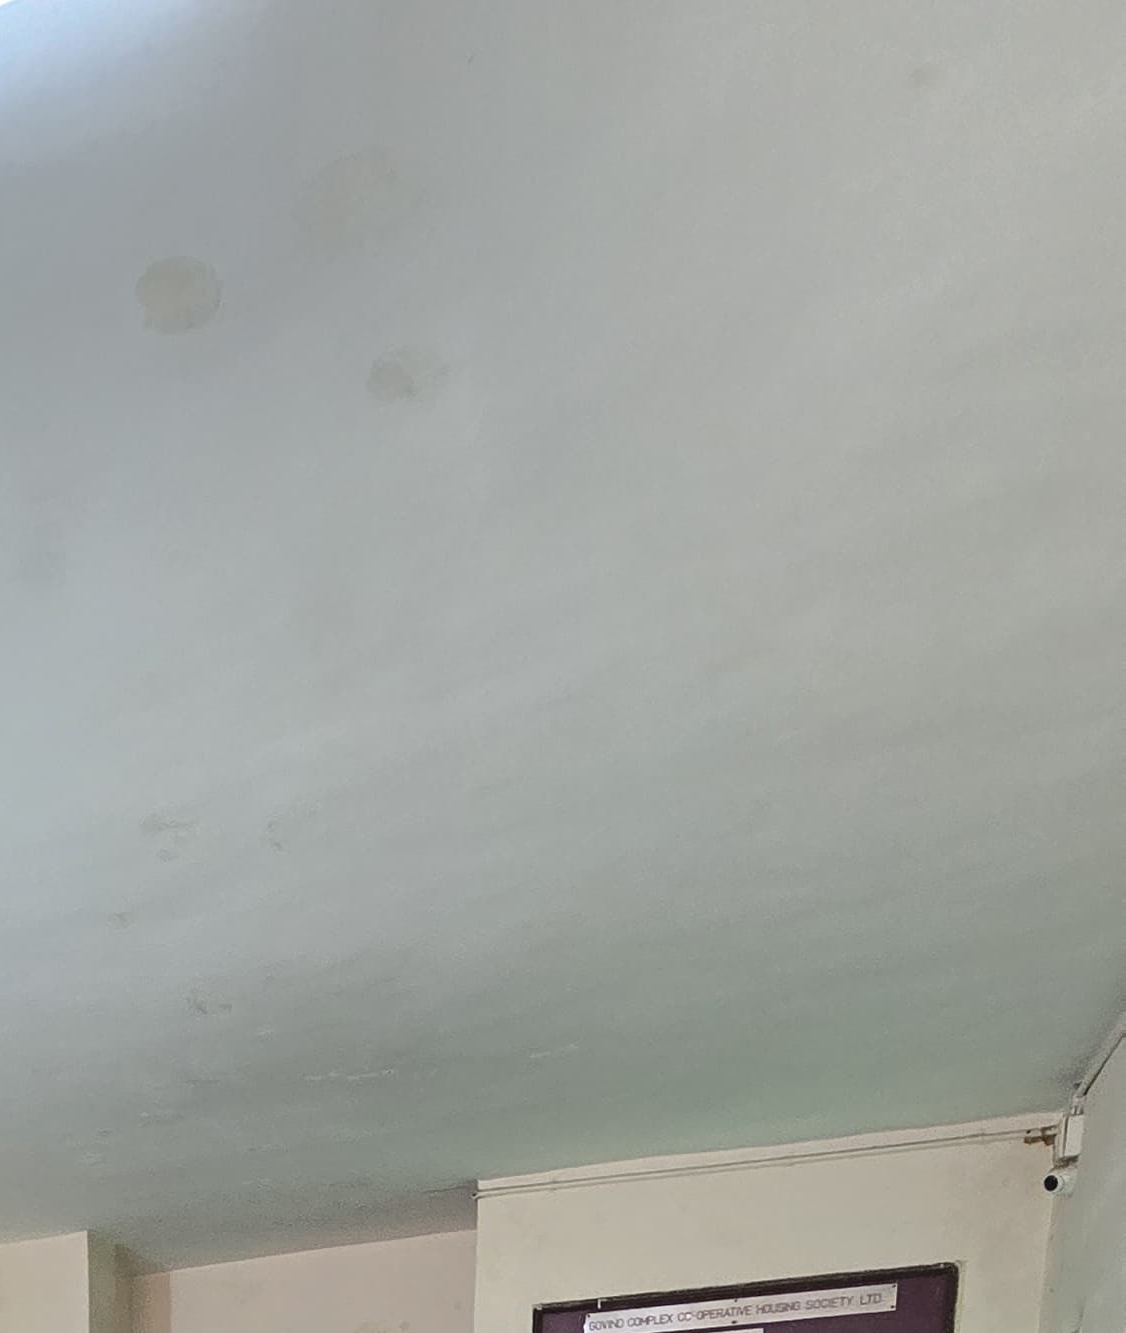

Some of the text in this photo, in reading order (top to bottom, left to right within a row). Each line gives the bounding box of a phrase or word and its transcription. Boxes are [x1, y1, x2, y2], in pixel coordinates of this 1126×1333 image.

[628, 1314, 674, 1328] COMPLEX
[756, 1301, 801, 1314] HOUSING
[805, 1296, 854, 1310] SOCIETY
